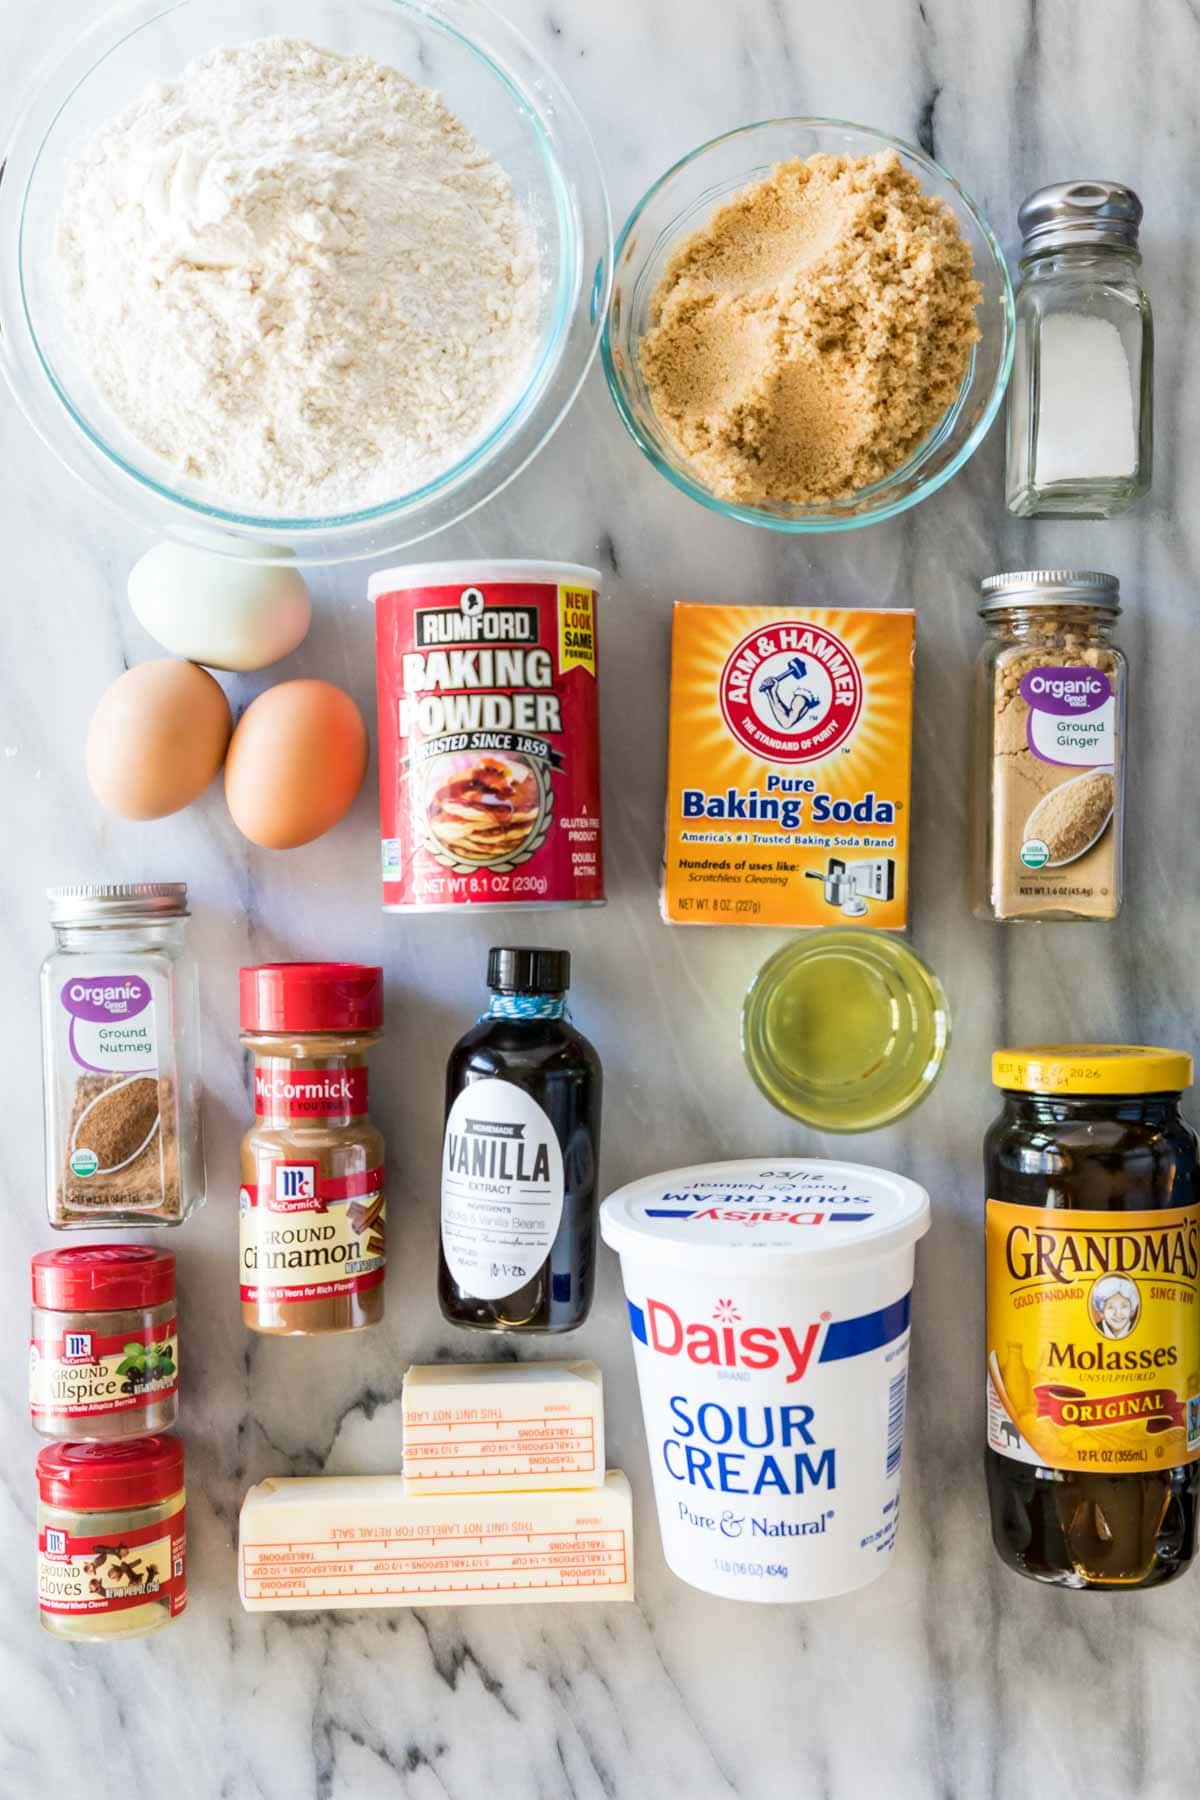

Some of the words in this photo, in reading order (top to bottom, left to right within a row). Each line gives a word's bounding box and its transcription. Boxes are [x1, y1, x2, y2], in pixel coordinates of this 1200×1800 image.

[565, 591, 589, 610] NEW
[422, 611, 532, 643] RUMFORD
[564, 610, 592, 631] LOOK
[564, 631, 592, 650] SAME
[402, 648, 553, 690] BAKING
[728, 649, 761, 704] ARM
[757, 637, 778, 657] &
[779, 629, 855, 707] HAMMER
[1030, 676, 1102, 698] Organic
[399, 694, 562, 736] POWDER
[741, 716, 755, 735] THE
[753, 731, 800, 751] STANDARD
[801, 737, 813, 750] OF
[813, 719, 839, 746] PURITY
[1057, 722, 1105, 733] Ground
[470, 733, 512, 749] SINCE
[516, 737, 548, 756] 1859
[1057, 736, 1100, 748] Ginger
[767, 775, 816, 793] Pure
[581, 804, 588, 815] A
[683, 790, 801, 828] Baking
[812, 793, 894, 823] Soda
[568, 831, 597, 842] PRODUCT
[681, 833, 732, 843] America's
[736, 834, 749, 843] #1
[753, 834, 791, 844] Trusted
[795, 835, 831, 847] Baking
[834, 836, 860, 846] Soda
[863, 837, 895, 848] Brand
[571, 853, 596, 864] DOUBLE
[574, 866, 596, 876] ACTING
[678, 859, 731, 870] Hundreds
[734, 859, 747, 870] of
[749, 862, 773, 871] uses
[776, 860, 800, 872] like:
[424, 877, 446, 893] NET
[447, 877, 467, 892] WT
[470, 877, 488, 892] 8.1
[491, 876, 509, 892] OZ
[512, 875, 548, 895] (230g)
[688, 872, 742, 884] Scratchless
[744, 874, 789, 887] Cleaning
[1020, 886, 1033, 895] NET
[1058, 887, 1067, 895] OZ
[679, 897, 694, 911] NET
[712, 898, 719, 911] 8
[735, 899, 761, 914] (227g)
[70, 980, 141, 1006] Organic
[99, 1027, 147, 1039] Ground
[99, 1042, 152, 1053] Nutmeg
[1070, 1068, 1101, 1080] 2026
[255, 1076, 350, 1098] McCormick
[448, 1132, 551, 1182] VANILLA
[468, 1182, 512, 1194] EXTRACT
[689, 1182, 760, 1192] Natural
[807, 1182, 848, 1192] Pure
[270, 1198, 321, 1212] McCormick
[661, 1192, 770, 1205] CREAM
[777, 1194, 873, 1205] SOUR
[693, 1207, 826, 1227] Daisy
[244, 1241, 361, 1269] Cinnamon
[1006, 1217, 1198, 1284] GRANDMA'S
[285, 1288, 303, 1297] Years
[304, 1287, 316, 1296] for
[316, 1284, 333, 1294] Rich
[334, 1281, 355, 1292] Flavor
[1150, 1287, 1176, 1301] SINCE
[1014, 1295, 1034, 1309] GOLD
[1035, 1288, 1084, 1306] STANDARD
[646, 1297, 821, 1384] Daisy
[1048, 1341, 1178, 1370] Molasses
[717, 1371, 750, 1382] BRAND
[1078, 1371, 1157, 1383] UNSULPHURED
[433, 1409, 453, 1421] NOT
[457, 1408, 478, 1420] UNIT
[480, 1408, 504, 1419] THIS
[1062, 1395, 1165, 1422] ORIGINAL
[669, 1395, 817, 1449] SOUR
[518, 1427, 575, 1438] TABLESPOONS
[480, 1442, 497, 1453] CUP
[516, 1440, 575, 1451] TABLESPOONS
[529, 1456, 575, 1465] TEASPOONS
[1077, 1450, 1087, 1461] 12
[1101, 1450, 1113, 1462] OZ
[663, 1438, 837, 1496] CREAM
[678, 1502, 716, 1531] Pure
[720, 1510, 746, 1538] &
[751, 1513, 826, 1537] Natural
[358, 1527, 391, 1540] RETAIL
[396, 1527, 414, 1539] FOR
[418, 1525, 460, 1538] LABELED
[463, 1523, 482, 1535] NOT
[486, 1522, 508, 1534] UNIT
[512, 1522, 534, 1533] THIS
[330, 1528, 355, 1541] SALE
[549, 1540, 605, 1551] TABLESPOONS
[258, 1553, 314, 1563] TABLESPOONS
[512, 1558, 527, 1567] CUP
[548, 1554, 605, 1565] TABLESPOONS
[41, 1564, 80, 1578] GROUND
[253, 1567, 269, 1576] CUP
[269, 1567, 281, 1576] 1/2
[289, 1564, 347, 1575] TABLESPOONS
[373, 1563, 390, 1572] CUP
[411, 1559, 469, 1571] TABLESPOONS
[748, 1563, 763, 1578] OZ)
[767, 1564, 788, 1578] 454g
[559, 1567, 605, 1577] TEASPOONS
[40, 1576, 82, 1597] Cloves
[260, 1579, 306, 1589] TEASPOONS
